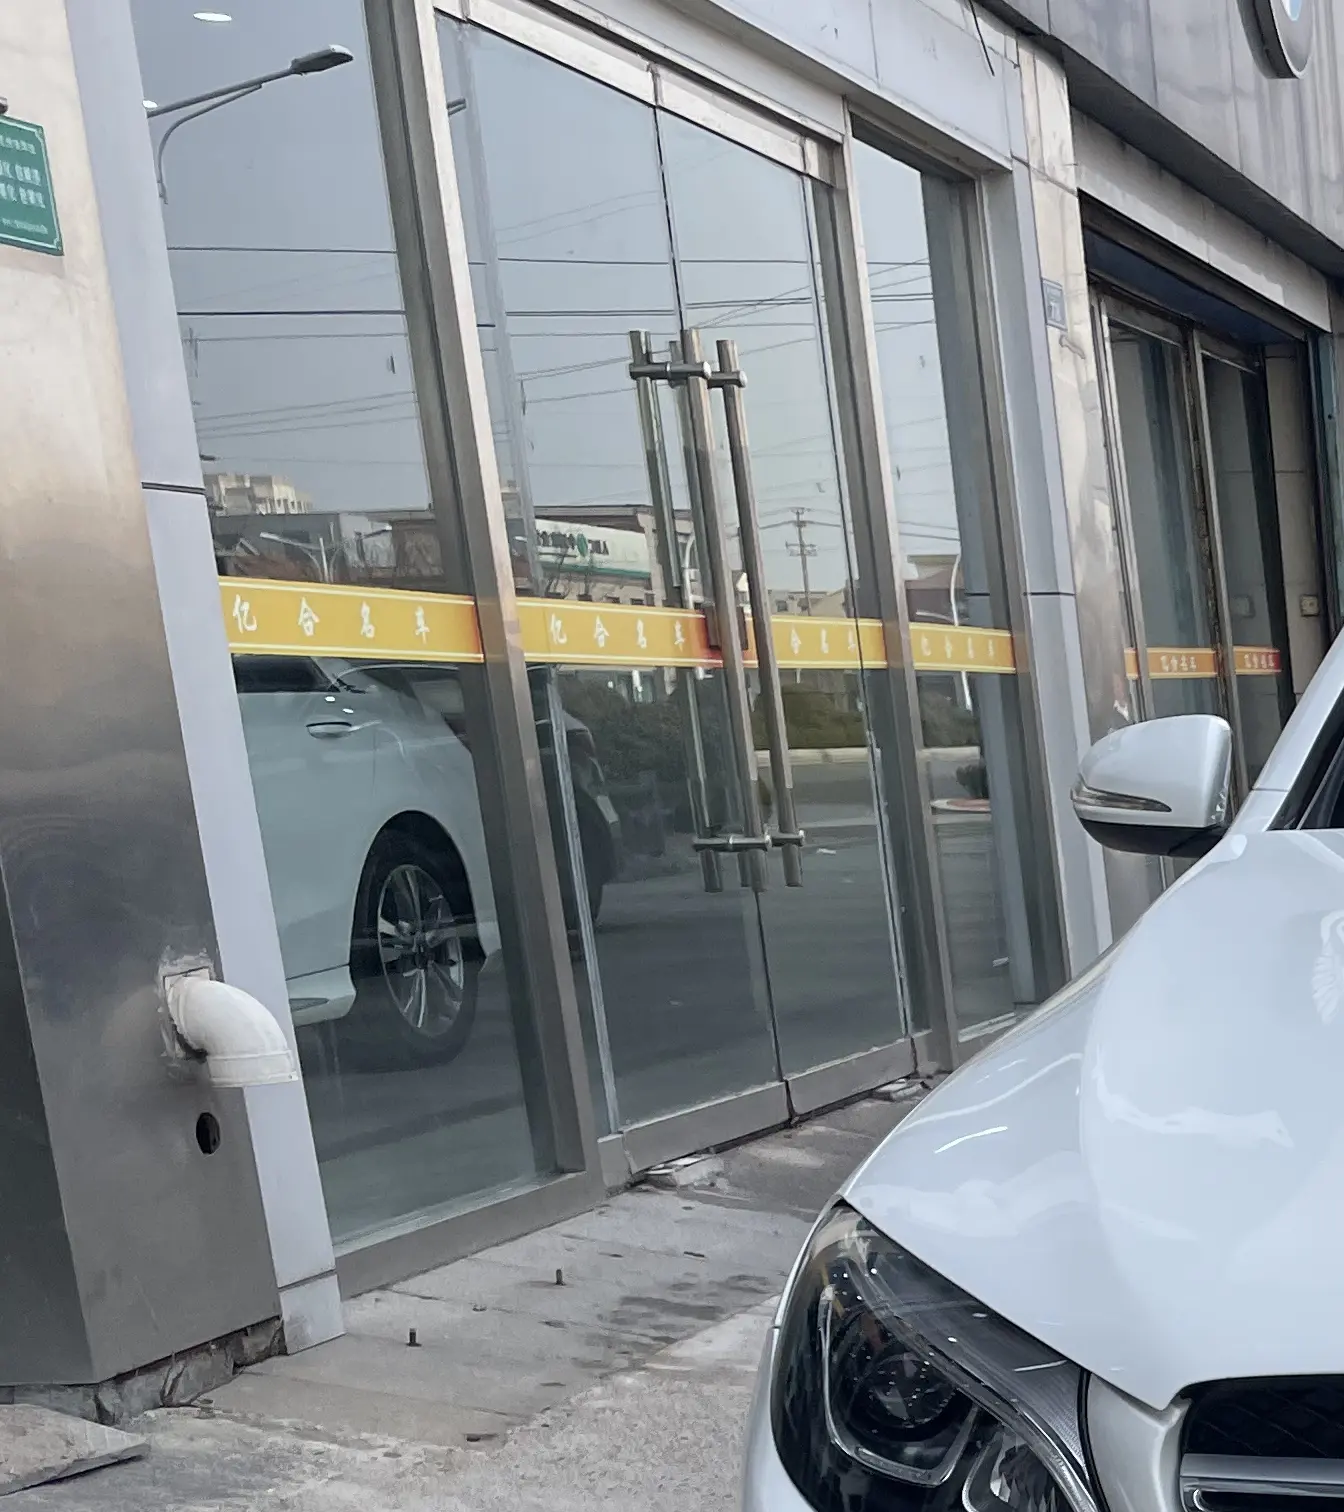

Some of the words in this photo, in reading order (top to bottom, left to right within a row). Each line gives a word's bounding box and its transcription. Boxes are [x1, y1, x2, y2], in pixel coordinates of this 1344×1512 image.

[232, 594, 430, 645] 亿合名车
[550, 613, 686, 652] 亿合名车
